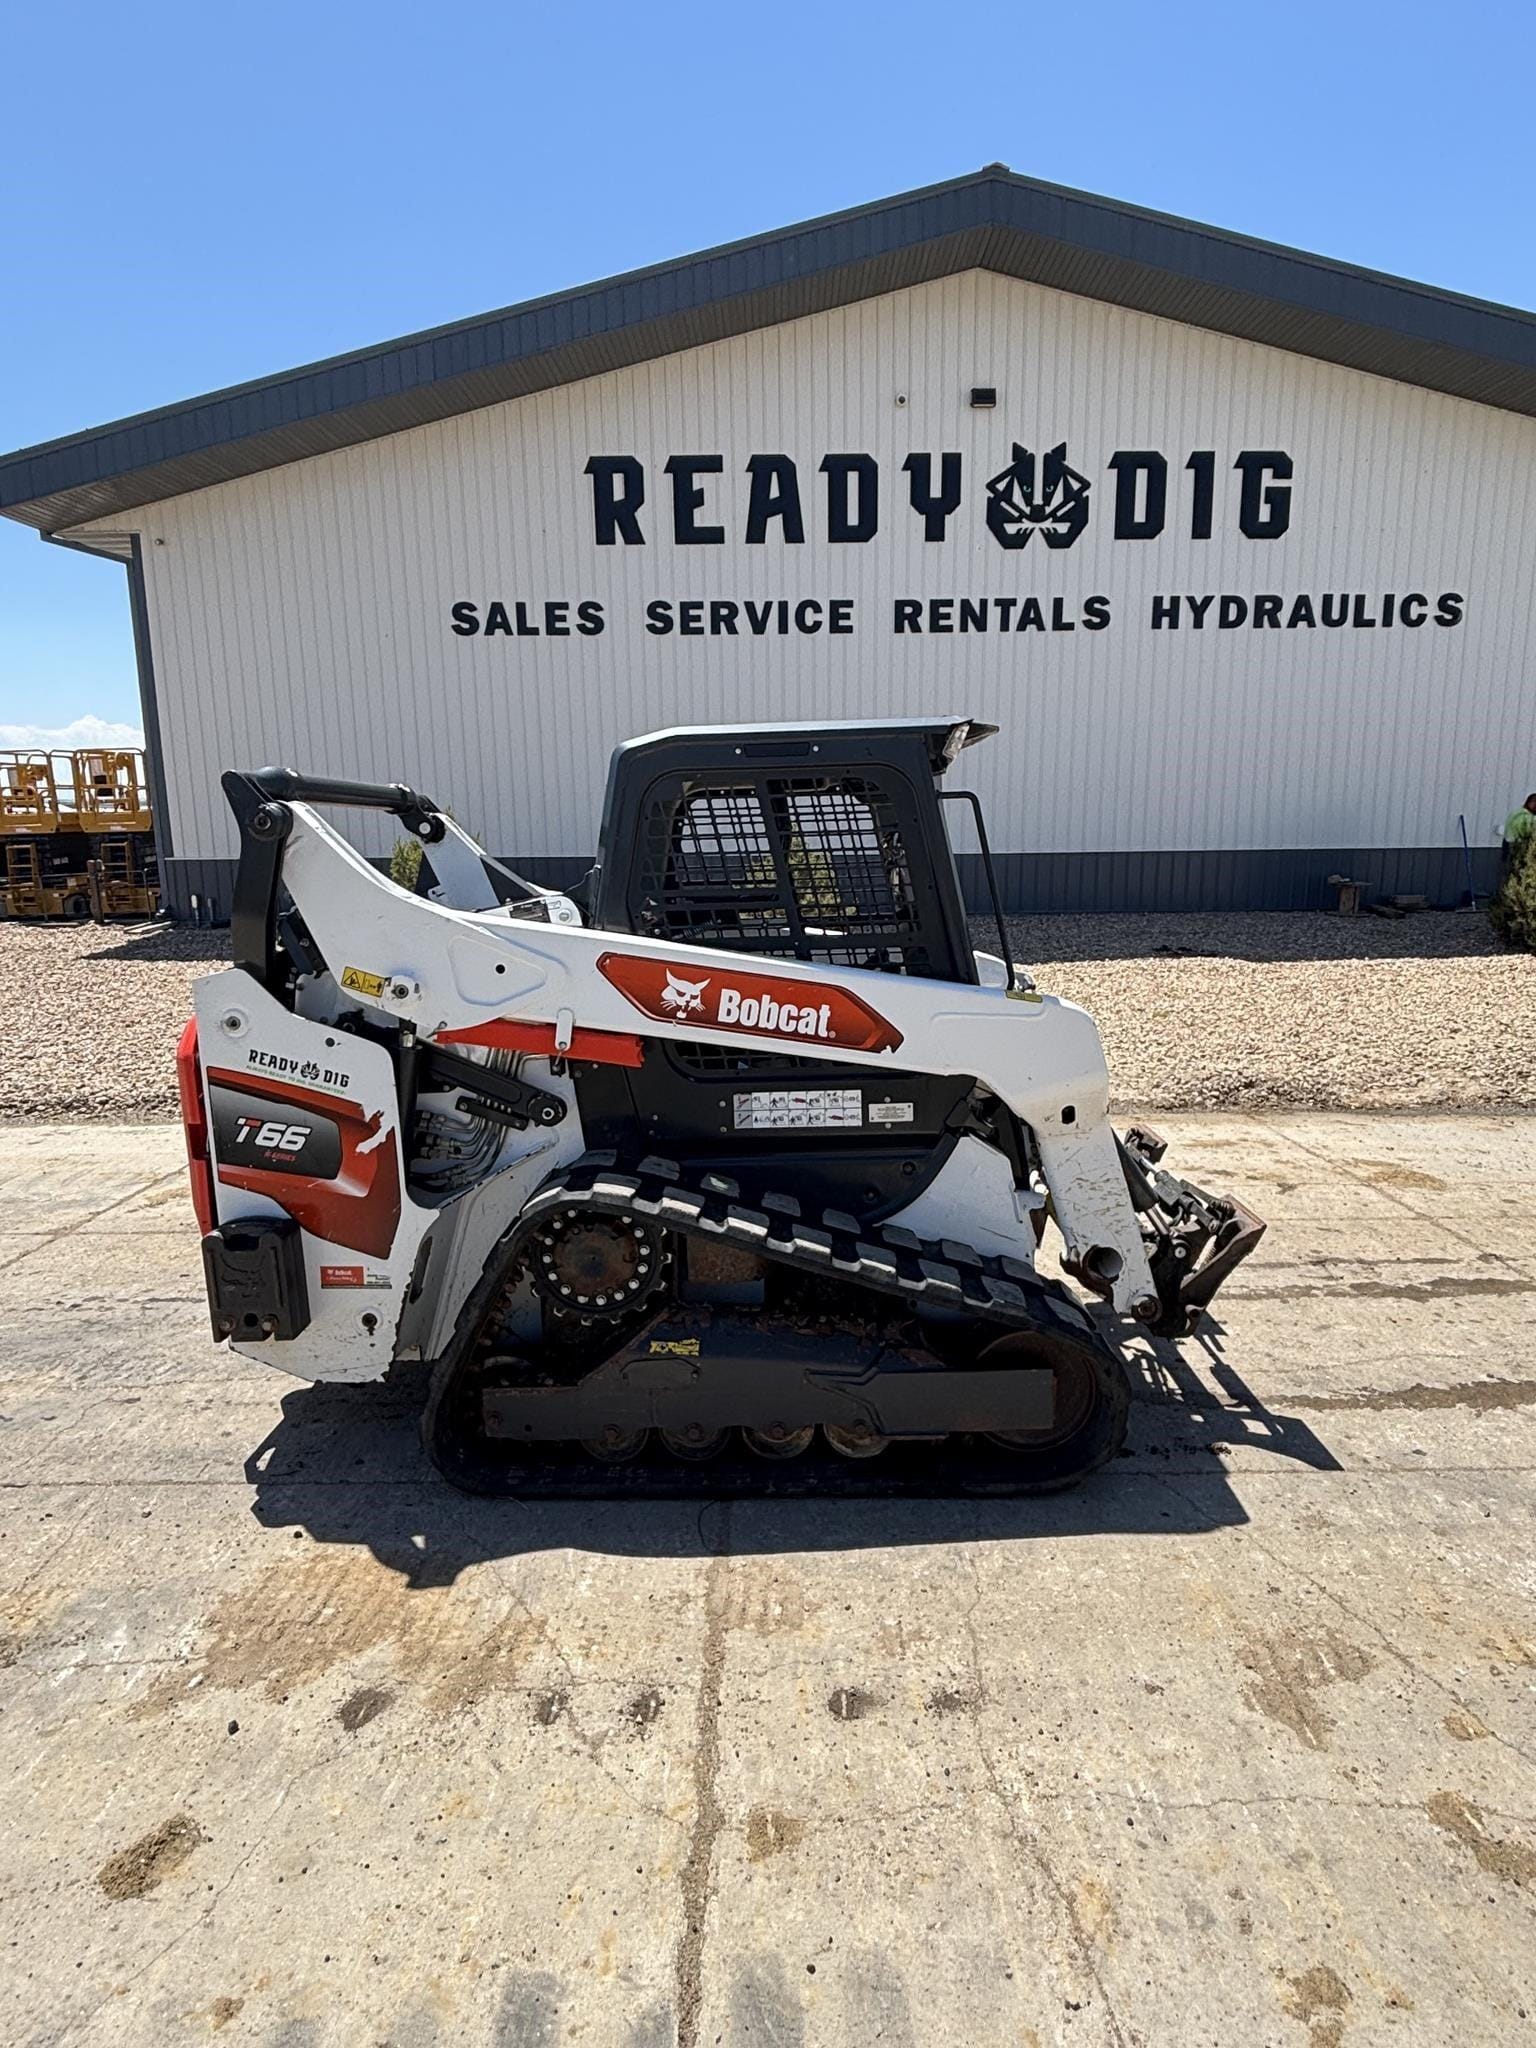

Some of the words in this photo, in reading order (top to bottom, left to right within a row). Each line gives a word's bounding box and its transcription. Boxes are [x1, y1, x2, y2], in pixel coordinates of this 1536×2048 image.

[584, 452, 962, 546] READY
[1107, 450, 1294, 541] DIG
[450, 601, 605, 637] SALES
[645, 599, 854, 636] SERVICE
[893, 595, 1111, 634] RENTALS
[1150, 592, 1464, 631] HYDRAULICS
[717, 987, 832, 1038] Bobcat
[248, 1048, 299, 1074] READY
[323, 1069, 350, 1088] DIG
[235, 1117, 312, 1151] T66
